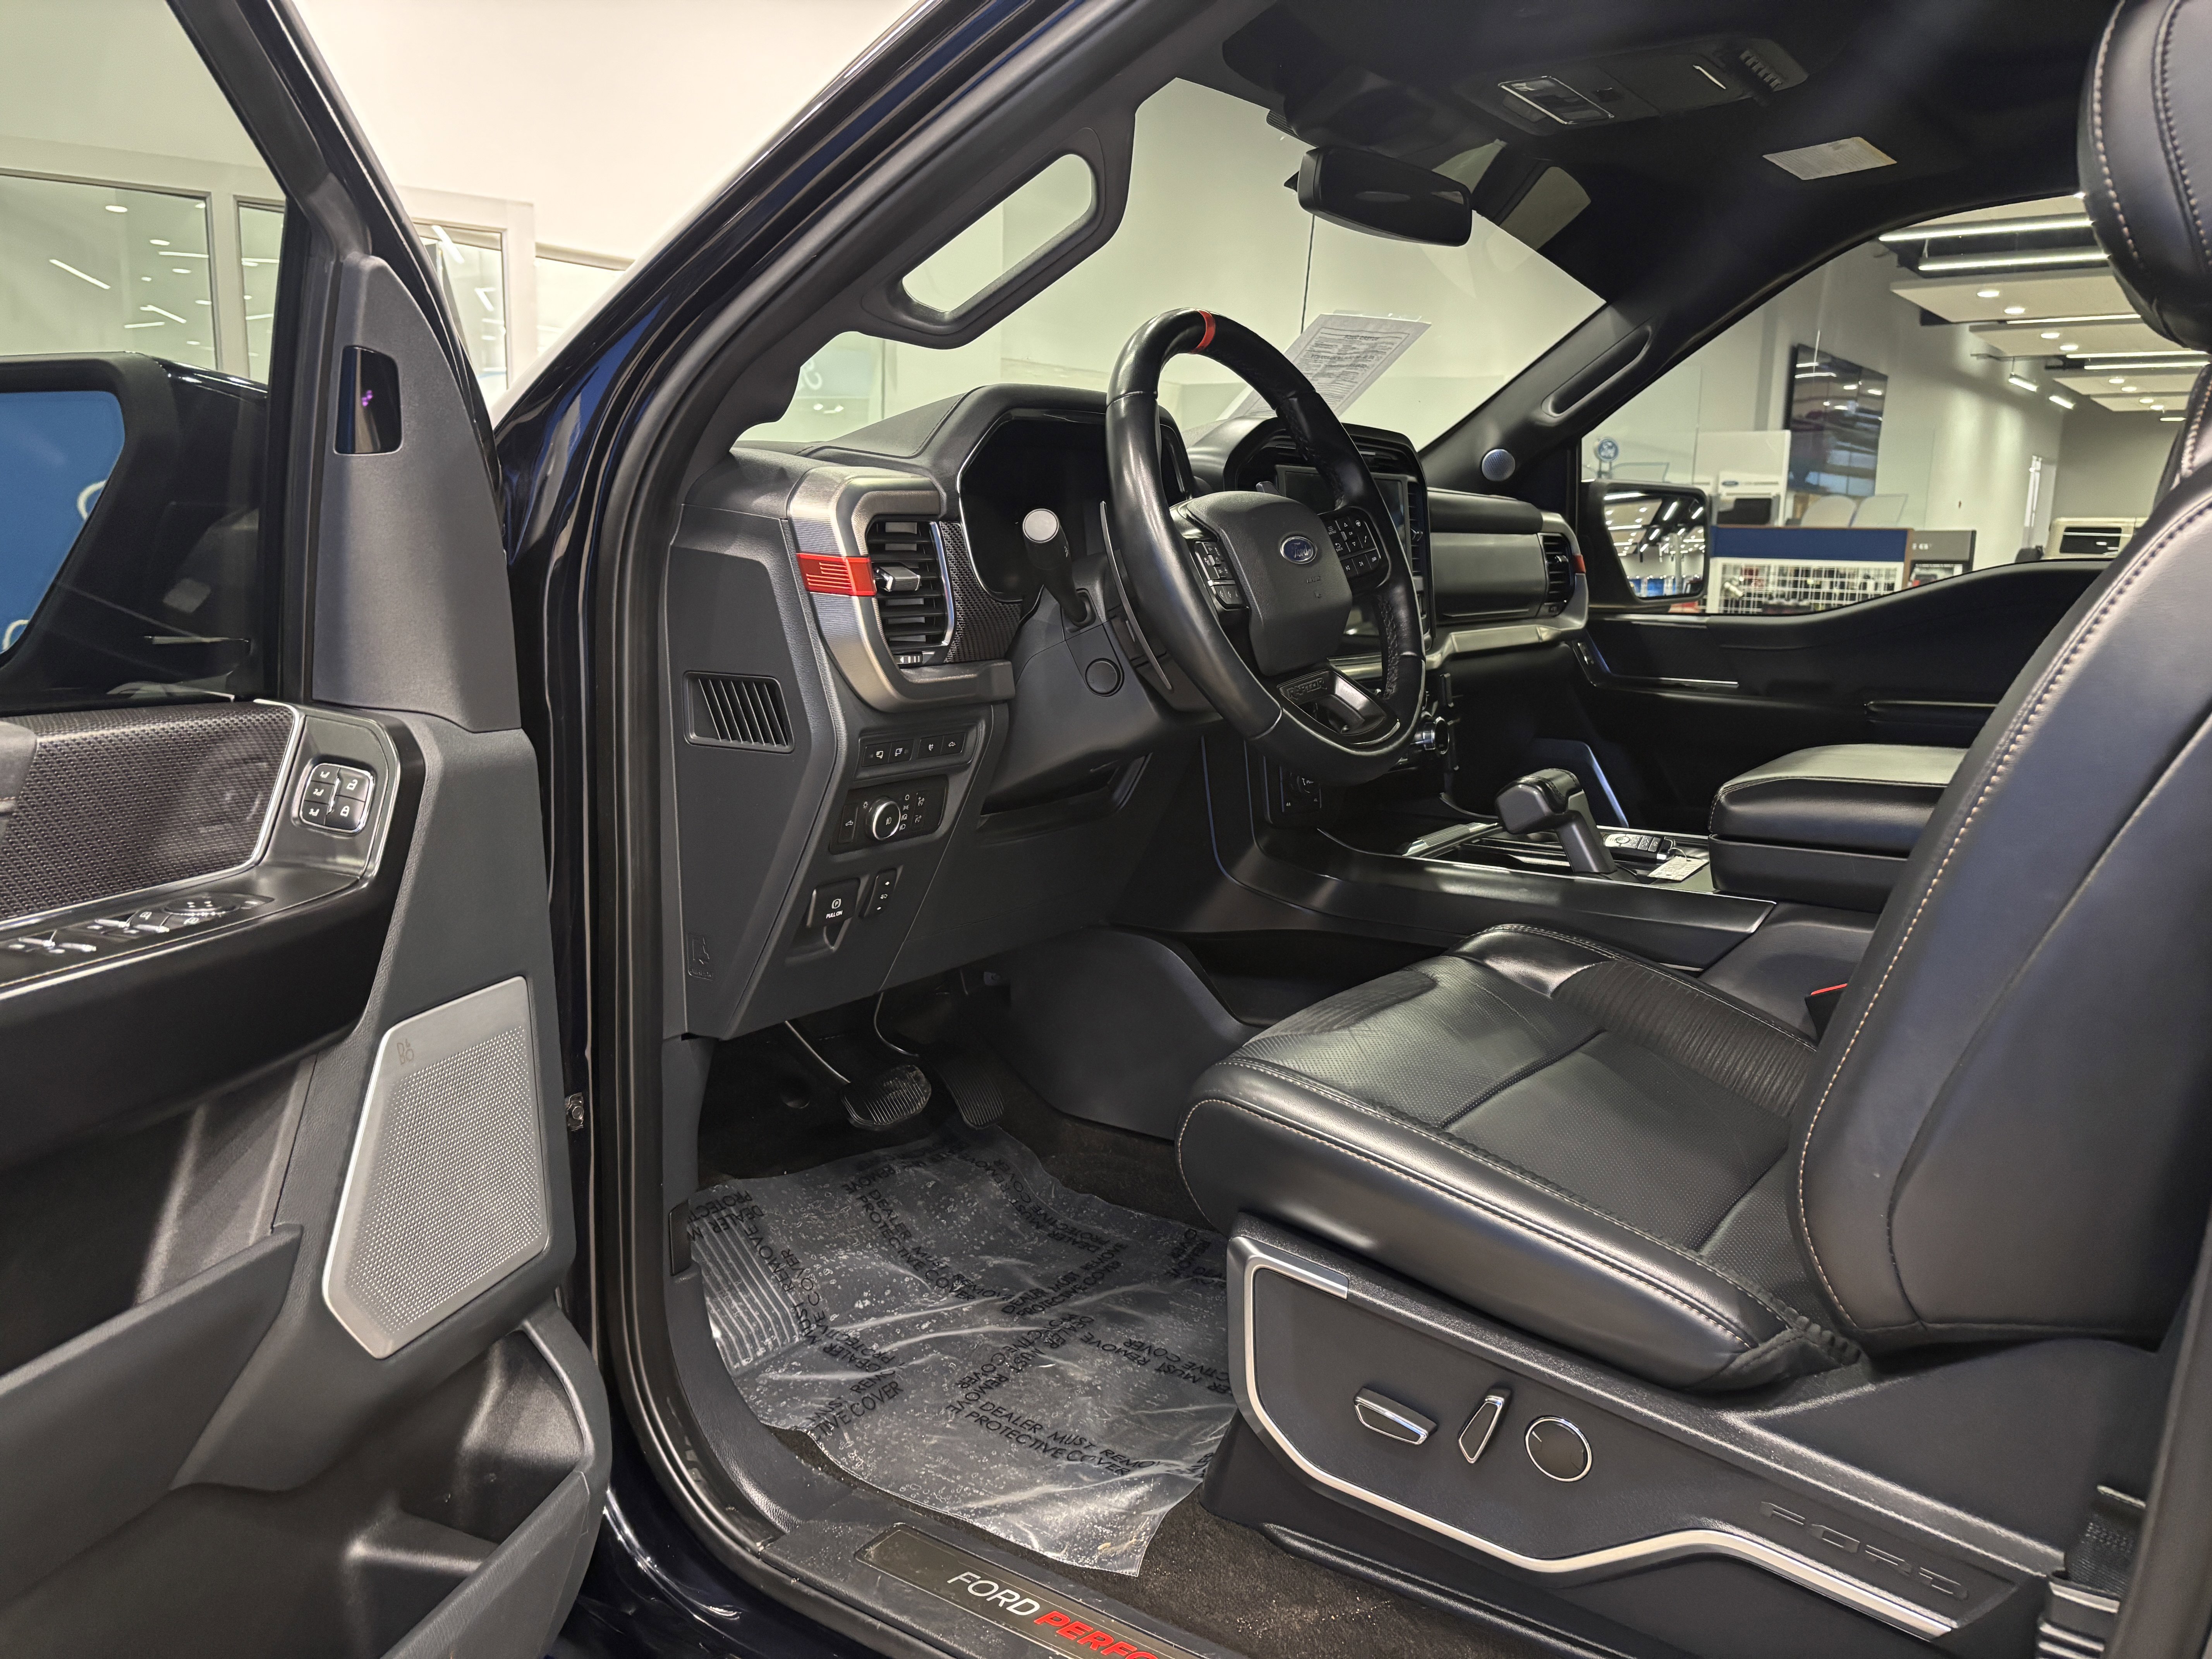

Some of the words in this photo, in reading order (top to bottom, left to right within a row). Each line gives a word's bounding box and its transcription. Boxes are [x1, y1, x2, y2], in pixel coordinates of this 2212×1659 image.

[710, 1204, 764, 1234] DEALER
[869, 1189, 912, 1240] DEALER
[912, 1246, 951, 1270] MUST
[1008, 1198, 1045, 1230] MUST
[744, 1224, 795, 1293] REMOVE
[856, 1195, 927, 1272] PROTECTIVE
[925, 1269, 976, 1301] COVER
[781, 1249, 820, 1306] COVER
[1001, 1288, 1047, 1314] DEALER
[1048, 1271, 1080, 1293] MUST
[1080, 1242, 1127, 1270] REMOVE
[1016, 1284, 1087, 1316] PROTECTIVE
[1083, 1260, 1121, 1285] COVER
[792, 1302, 821, 1346] MUST
[823, 1342, 881, 1372] DEALER
[955, 1352, 1006, 1389] COVER
[1080, 1331, 1151, 1367] REMOVE
[1123, 1338, 1181, 1362] COVER
[946, 1374, 1009, 1414] REMOVE
[1155, 1362, 1202, 1384] MUST
[850, 1381, 904, 1417] COVER
[965, 1411, 1066, 1458] PROTECTIVE
[1066, 1450, 1132, 1475] COVER
[980, 1401, 1043, 1434] DEALER
[1047, 1432, 1096, 1449] MUST
[1760, 1501, 1968, 1601] FORD
[947, 1571, 1041, 1616] FORD
